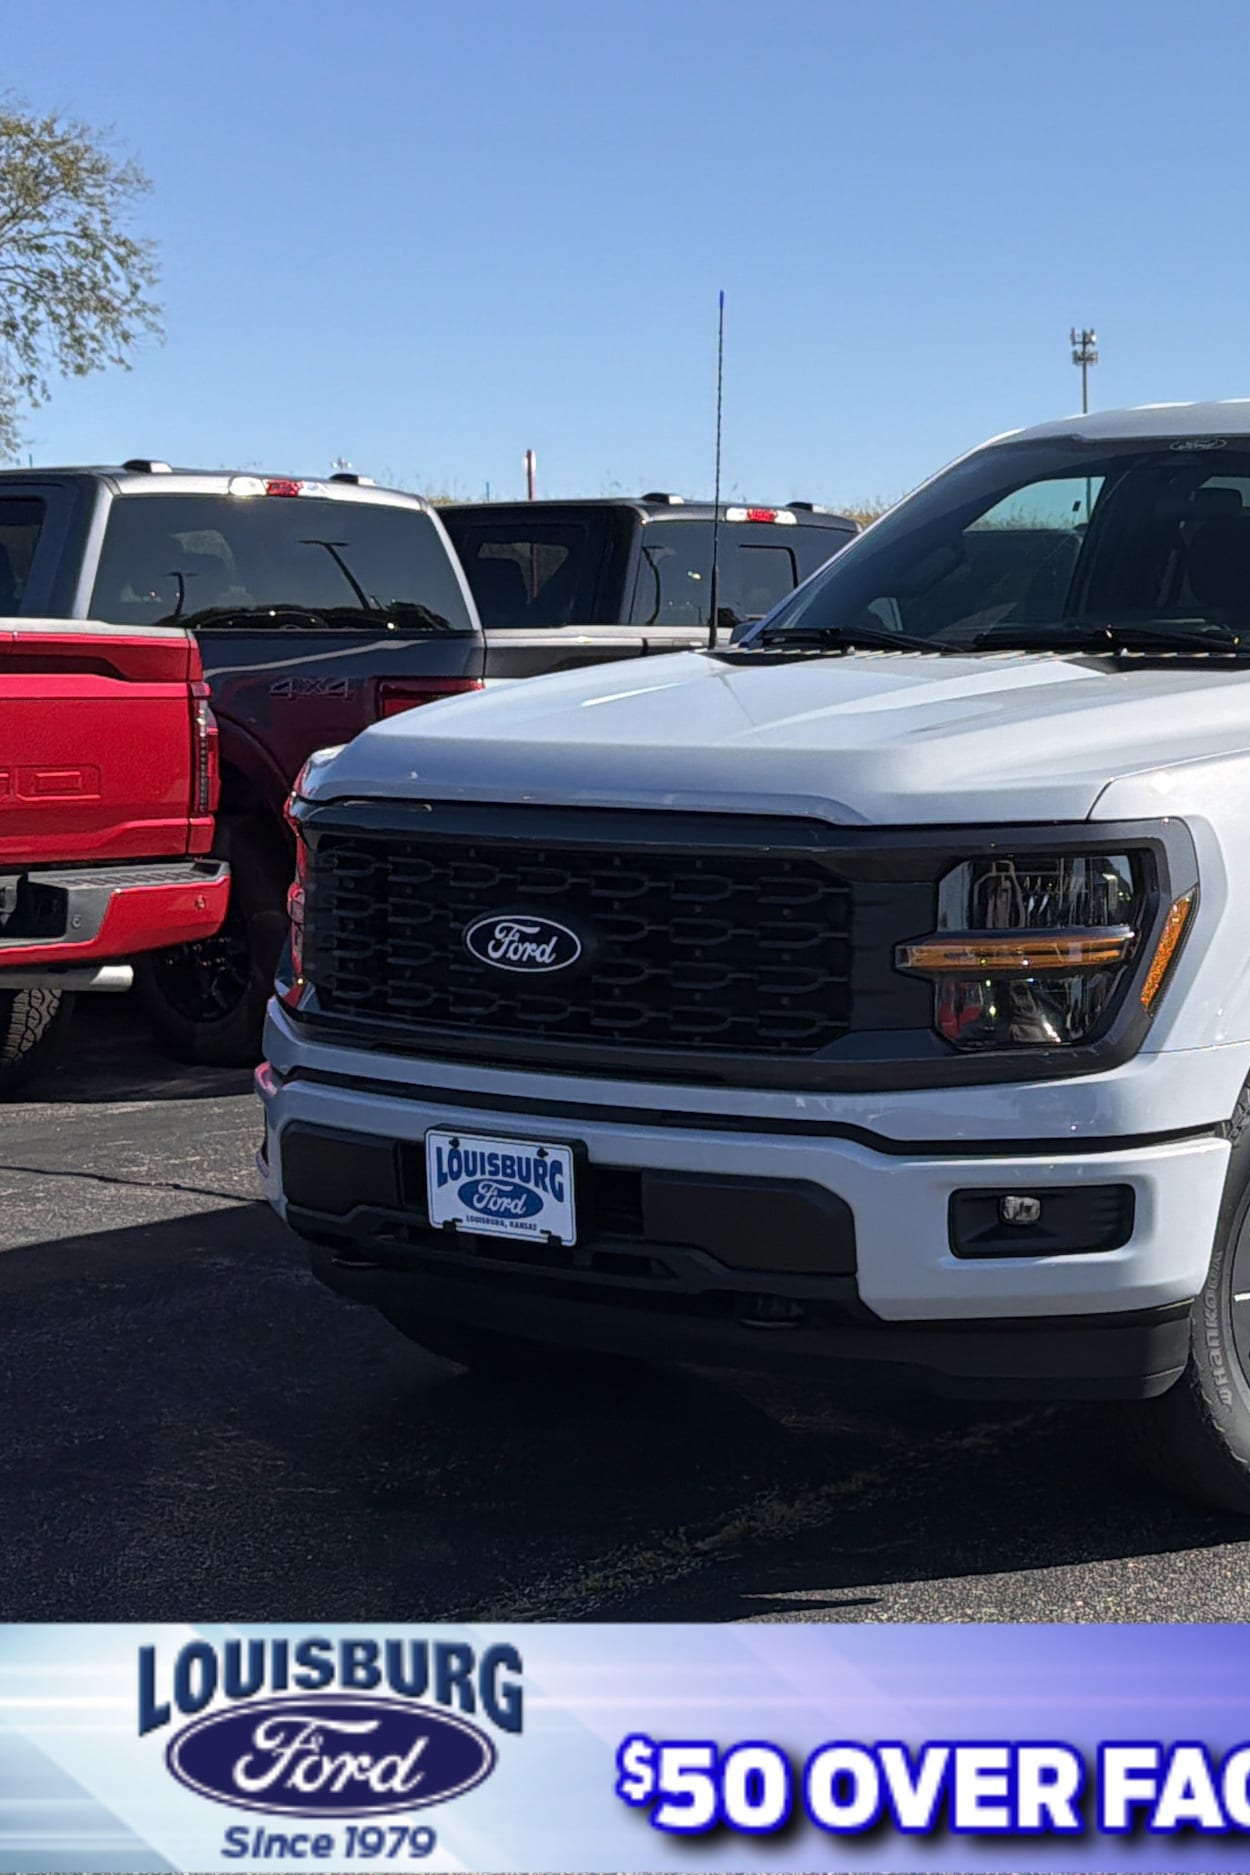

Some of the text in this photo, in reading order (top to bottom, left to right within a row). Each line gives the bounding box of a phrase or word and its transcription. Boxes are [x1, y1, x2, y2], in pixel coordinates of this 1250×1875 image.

[487, 922, 558, 964] Ford
[436, 1146, 565, 1203] LOUISBURG
[473, 1181, 527, 1215] Ford
[509, 1220, 538, 1232] KANSAS
